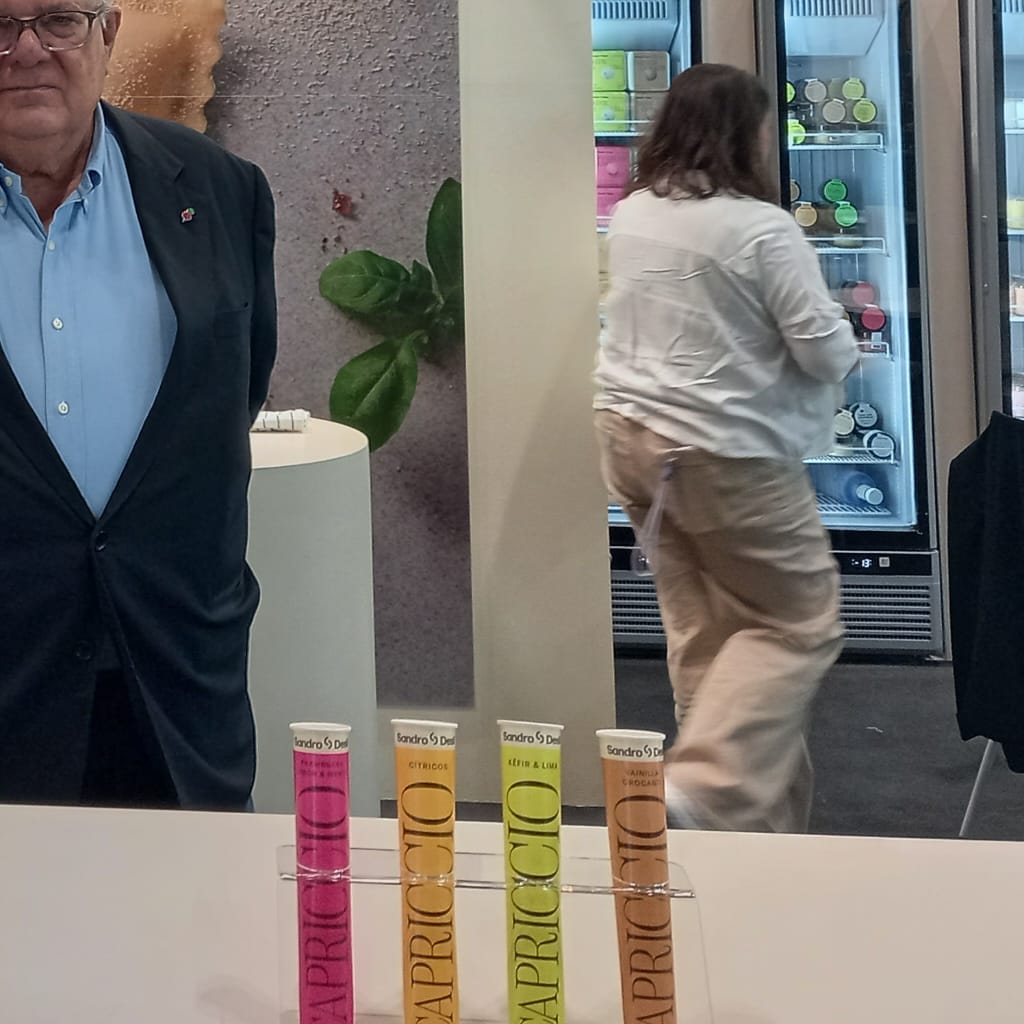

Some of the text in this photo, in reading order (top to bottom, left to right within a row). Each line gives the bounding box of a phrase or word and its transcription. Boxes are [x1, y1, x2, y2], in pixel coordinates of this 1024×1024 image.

[295, 736, 323, 750] Sandro
[397, 732, 429, 746] Sandro
[503, 731, 535, 744] Sandro
[607, 744, 643, 758] Sandro
[298, 785, 348, 1024] APRICCIO
[401, 782, 454, 1024] APRICCIO
[507, 780, 559, 1024] APRICCIO
